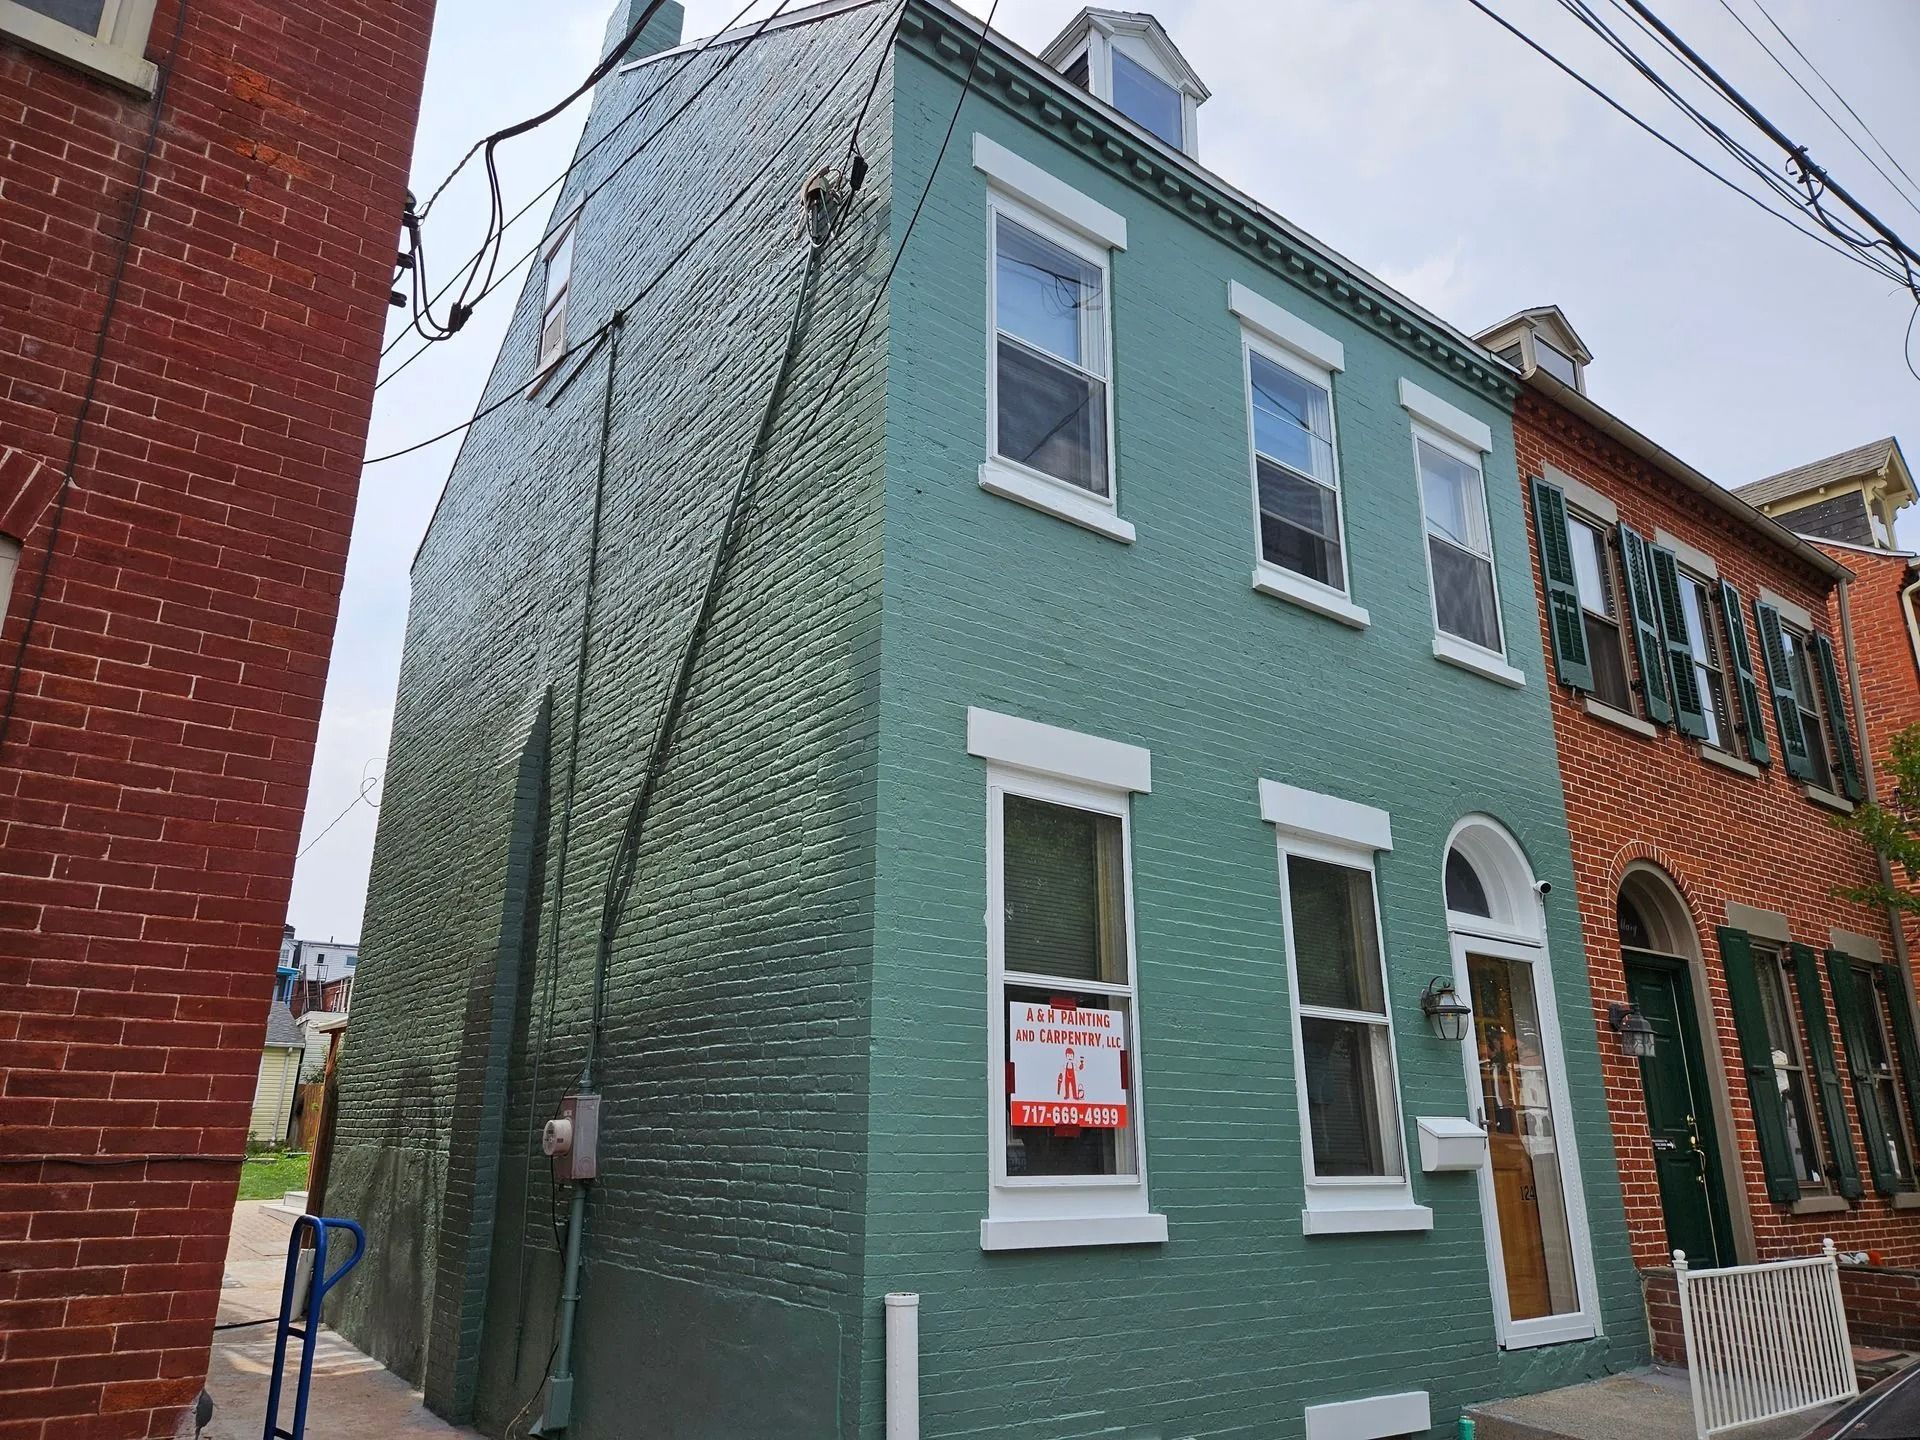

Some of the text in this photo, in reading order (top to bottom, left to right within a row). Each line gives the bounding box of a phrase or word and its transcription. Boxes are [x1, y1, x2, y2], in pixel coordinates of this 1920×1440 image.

[1026, 1007, 1111, 1028] A & H PAINTING
[1016, 1029, 1035, 1042] AND
[1107, 1036, 1121, 1049] LLC
[1022, 1105, 1119, 1126] 717-669-4999
